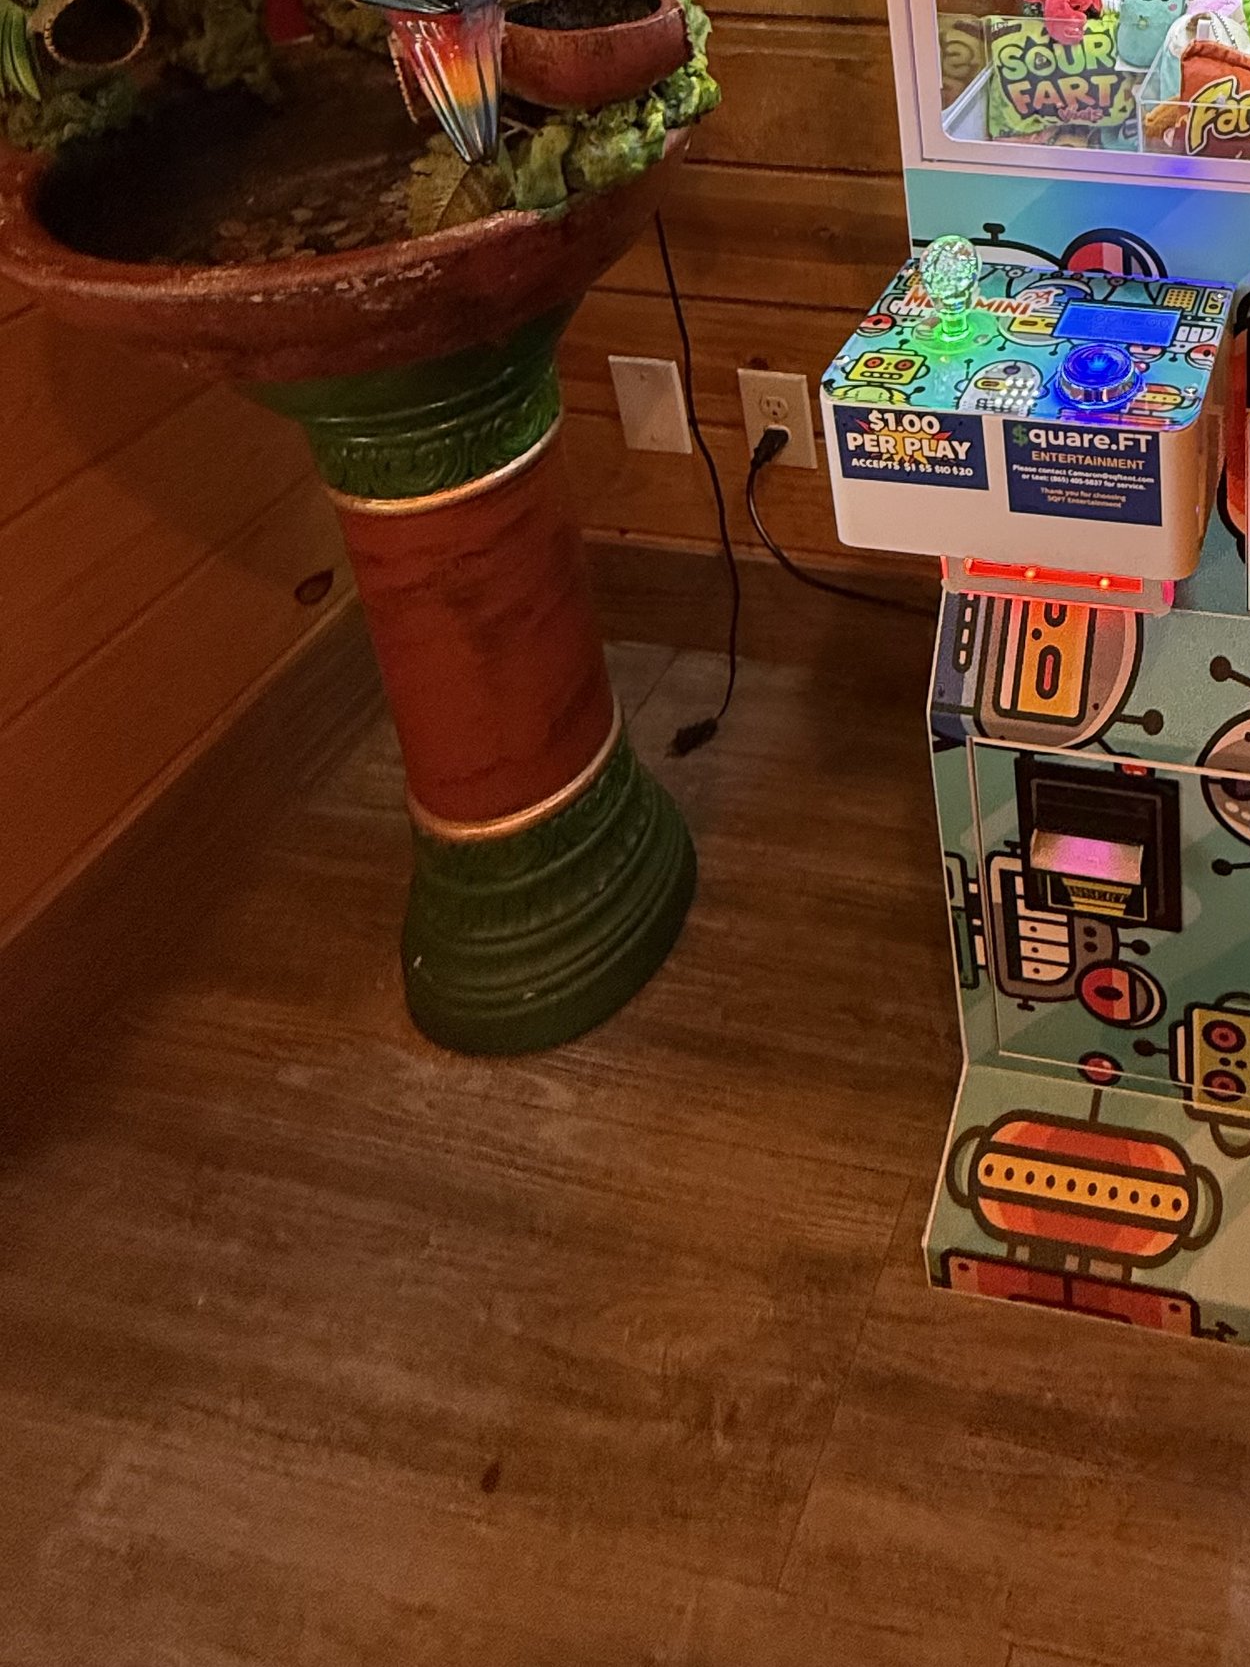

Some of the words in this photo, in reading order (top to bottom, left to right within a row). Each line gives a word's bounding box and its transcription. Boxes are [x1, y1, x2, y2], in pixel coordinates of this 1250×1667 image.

[1000, 33, 1115, 81] SOUR
[1007, 75, 1119, 114] FART
[975, 297, 1031, 315] MINI
[868, 409, 941, 435] $1.00
[846, 432, 897, 454] PER
[904, 437, 971, 460] PLAY
[1012, 424, 1153, 453] $quare.FT
[851, 457, 900, 471] ACCEPTS
[903, 462, 916, 472] $1
[918, 463, 933, 473] $5
[934, 464, 951, 475] $10
[952, 465, 974, 477] $20
[1012, 464, 1037, 473] Please
[1038, 466, 1067, 476] contact
[1031, 450, 1145, 470] ENTERTAINMENT
[1041, 487, 1064, 496] Thank
[1064, 489, 1080, 498] you
[1080, 490, 1092, 499] for
[1092, 492, 1126, 503] choosing
[1103, 480, 1115, 488] for
[1116, 482, 1147, 491] service.
[1067, 497, 1122, 509] Entertainment
